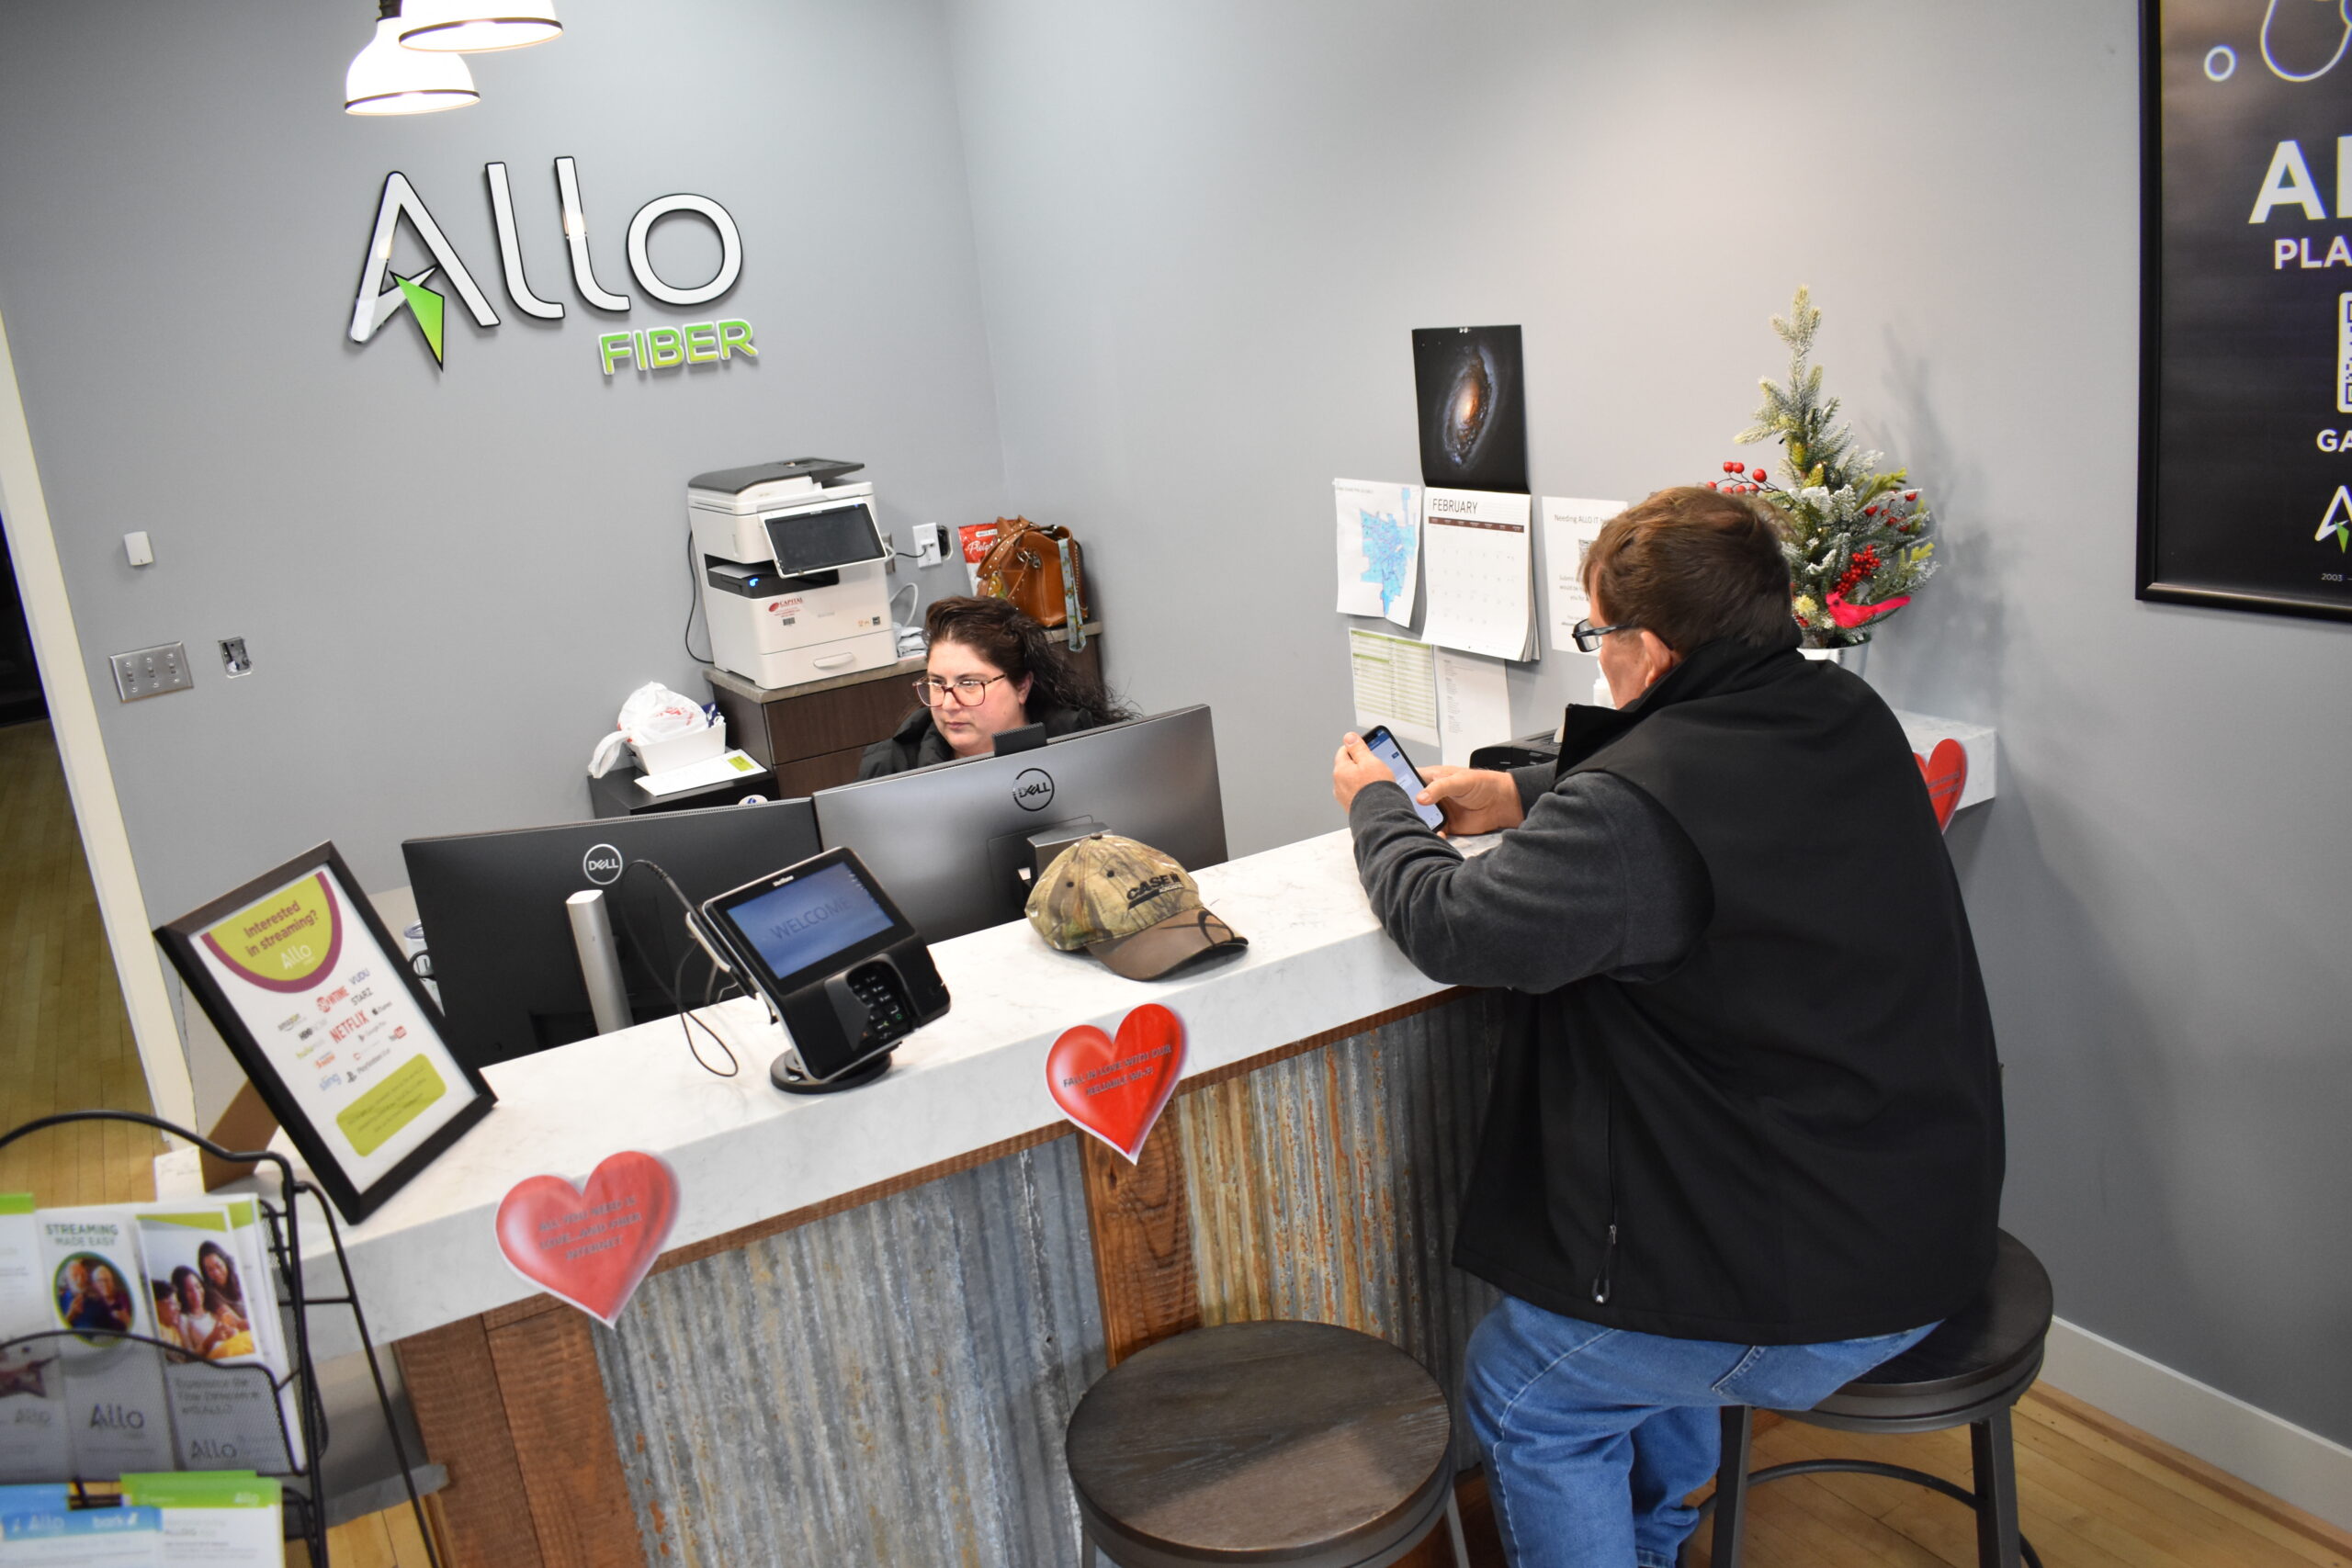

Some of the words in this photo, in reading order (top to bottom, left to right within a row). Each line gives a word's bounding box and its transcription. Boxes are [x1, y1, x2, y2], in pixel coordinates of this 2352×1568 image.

[348, 155, 742, 371] Allo
[597, 318, 760, 375] FIBER
[1432, 498, 1478, 514] FEBRUARY
[2321, 573, 2343, 582] 2003
[1018, 782, 1051, 798] DELL
[588, 858, 619, 872] DELL
[1126, 874, 1170, 899] CASE
[243, 900, 301, 939] Interested
[771, 895, 852, 940] WELCOME
[245, 945, 261, 958] in
[260, 909, 319, 950] streaming?
[281, 943, 312, 970] Allo
[351, 987, 374, 1007] STARZ
[329, 1010, 370, 1044] NETFLIX
[1063, 1075, 1085, 1088] FALL
[1086, 1070, 1097, 1081] IN
[1099, 1063, 1122, 1075] LOVE
[1124, 1054, 1149, 1067] WITH
[1151, 1044, 1172, 1058] OUR
[563, 1211, 588, 1224] YOU
[592, 1200, 622, 1215] NEED
[45, 1224, 119, 1236] STREAMING
[90, 1404, 145, 1430] Allo
[190, 1438, 238, 1460] Allo
